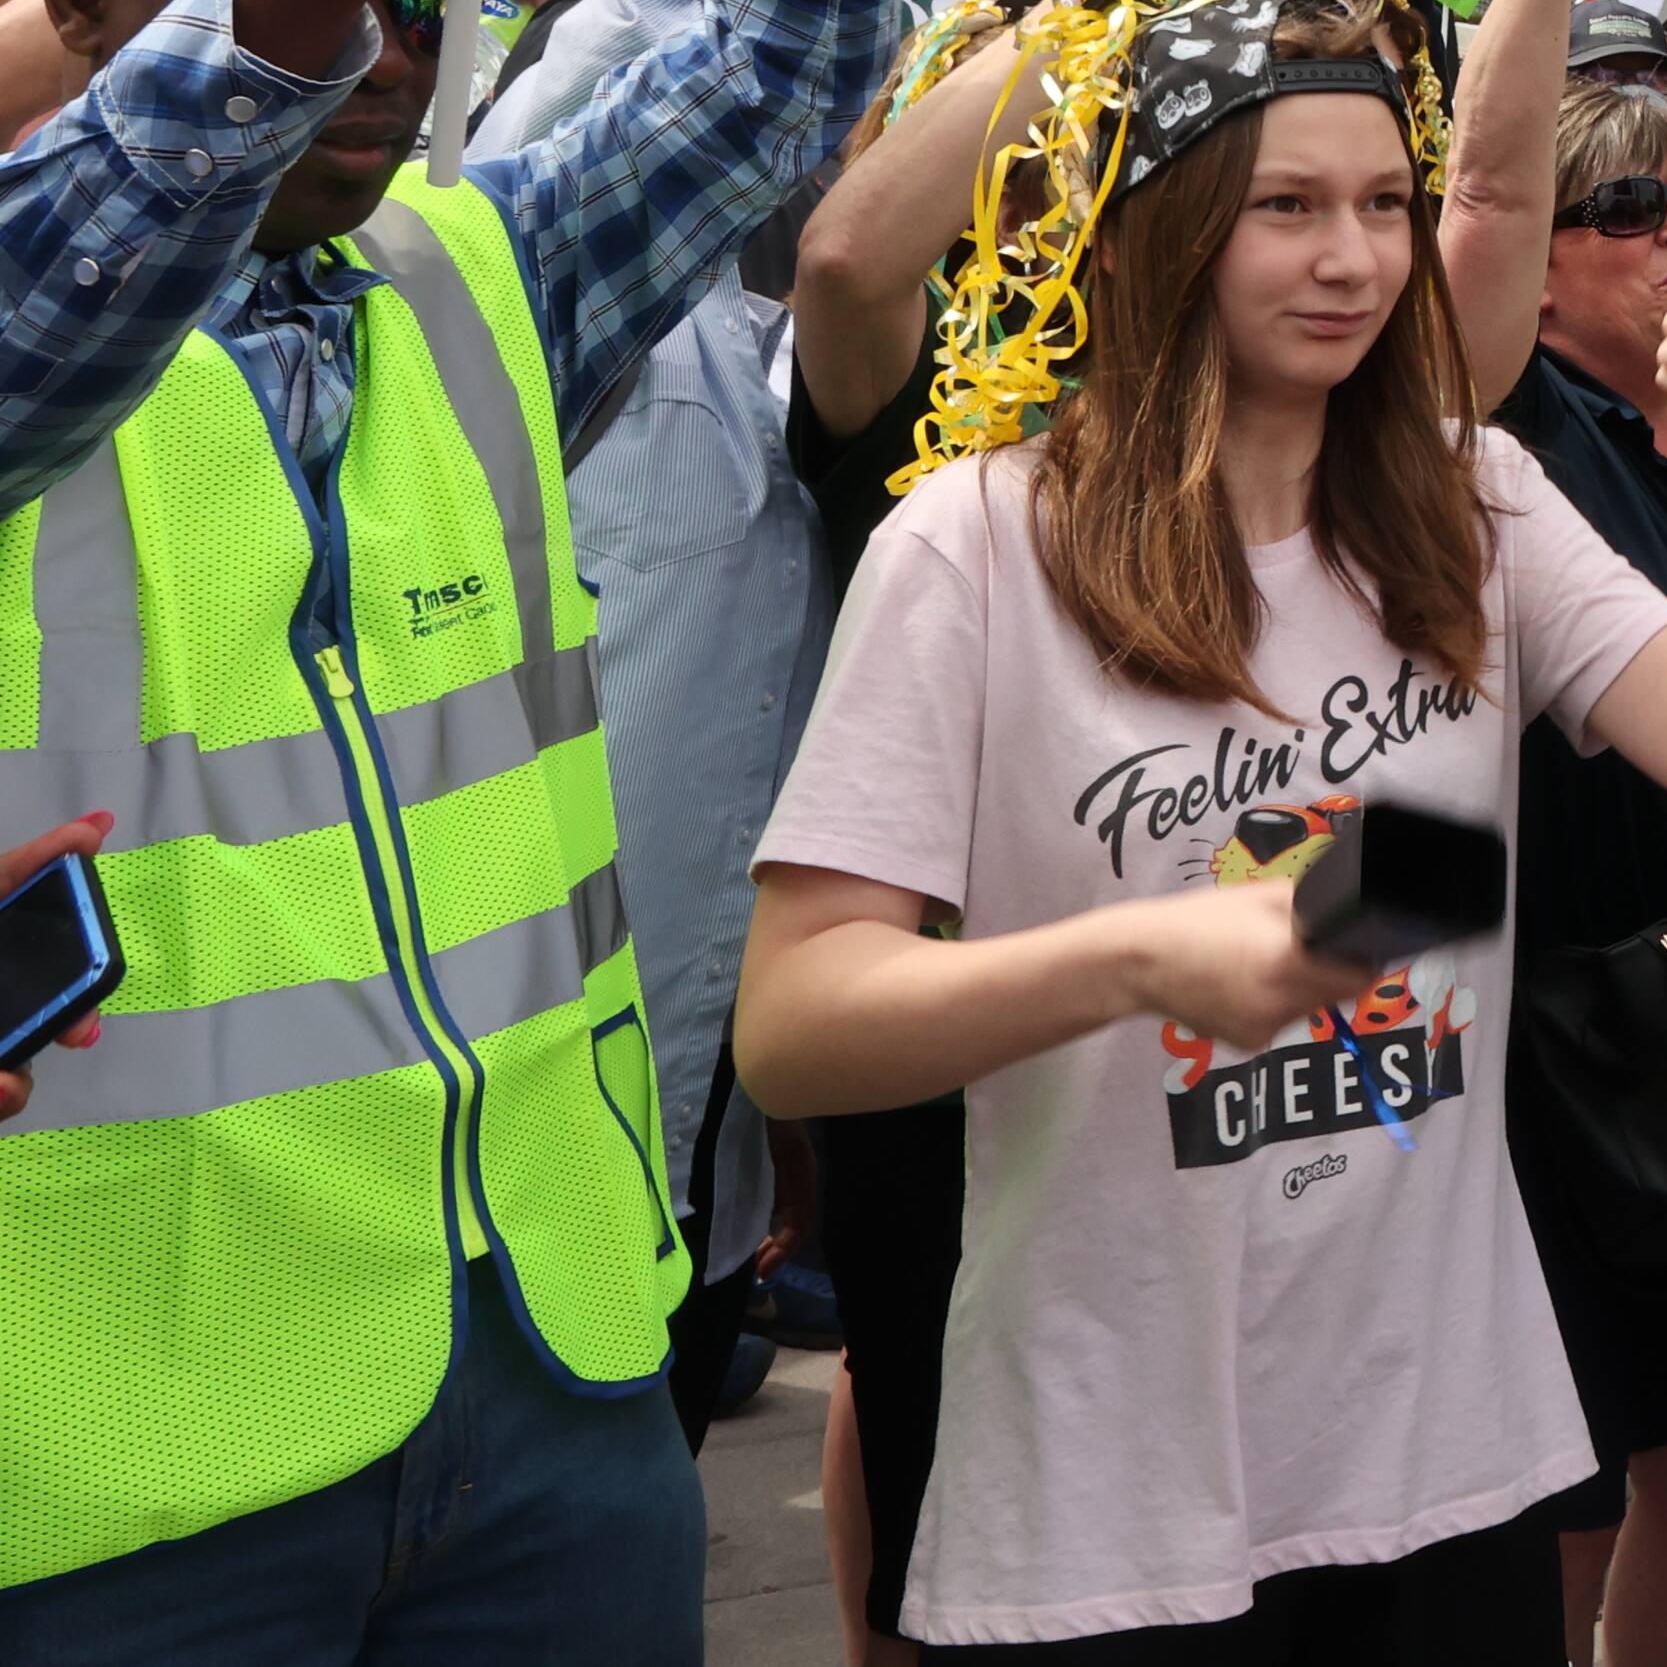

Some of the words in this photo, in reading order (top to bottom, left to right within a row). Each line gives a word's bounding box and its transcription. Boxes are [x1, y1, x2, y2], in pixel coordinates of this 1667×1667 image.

[1073, 727, 1304, 879] Feelin'
[1320, 659, 1478, 784] Extra
[1214, 1039, 1437, 1148] CHEESY
[1283, 1154, 1348, 1199] Cheetos
